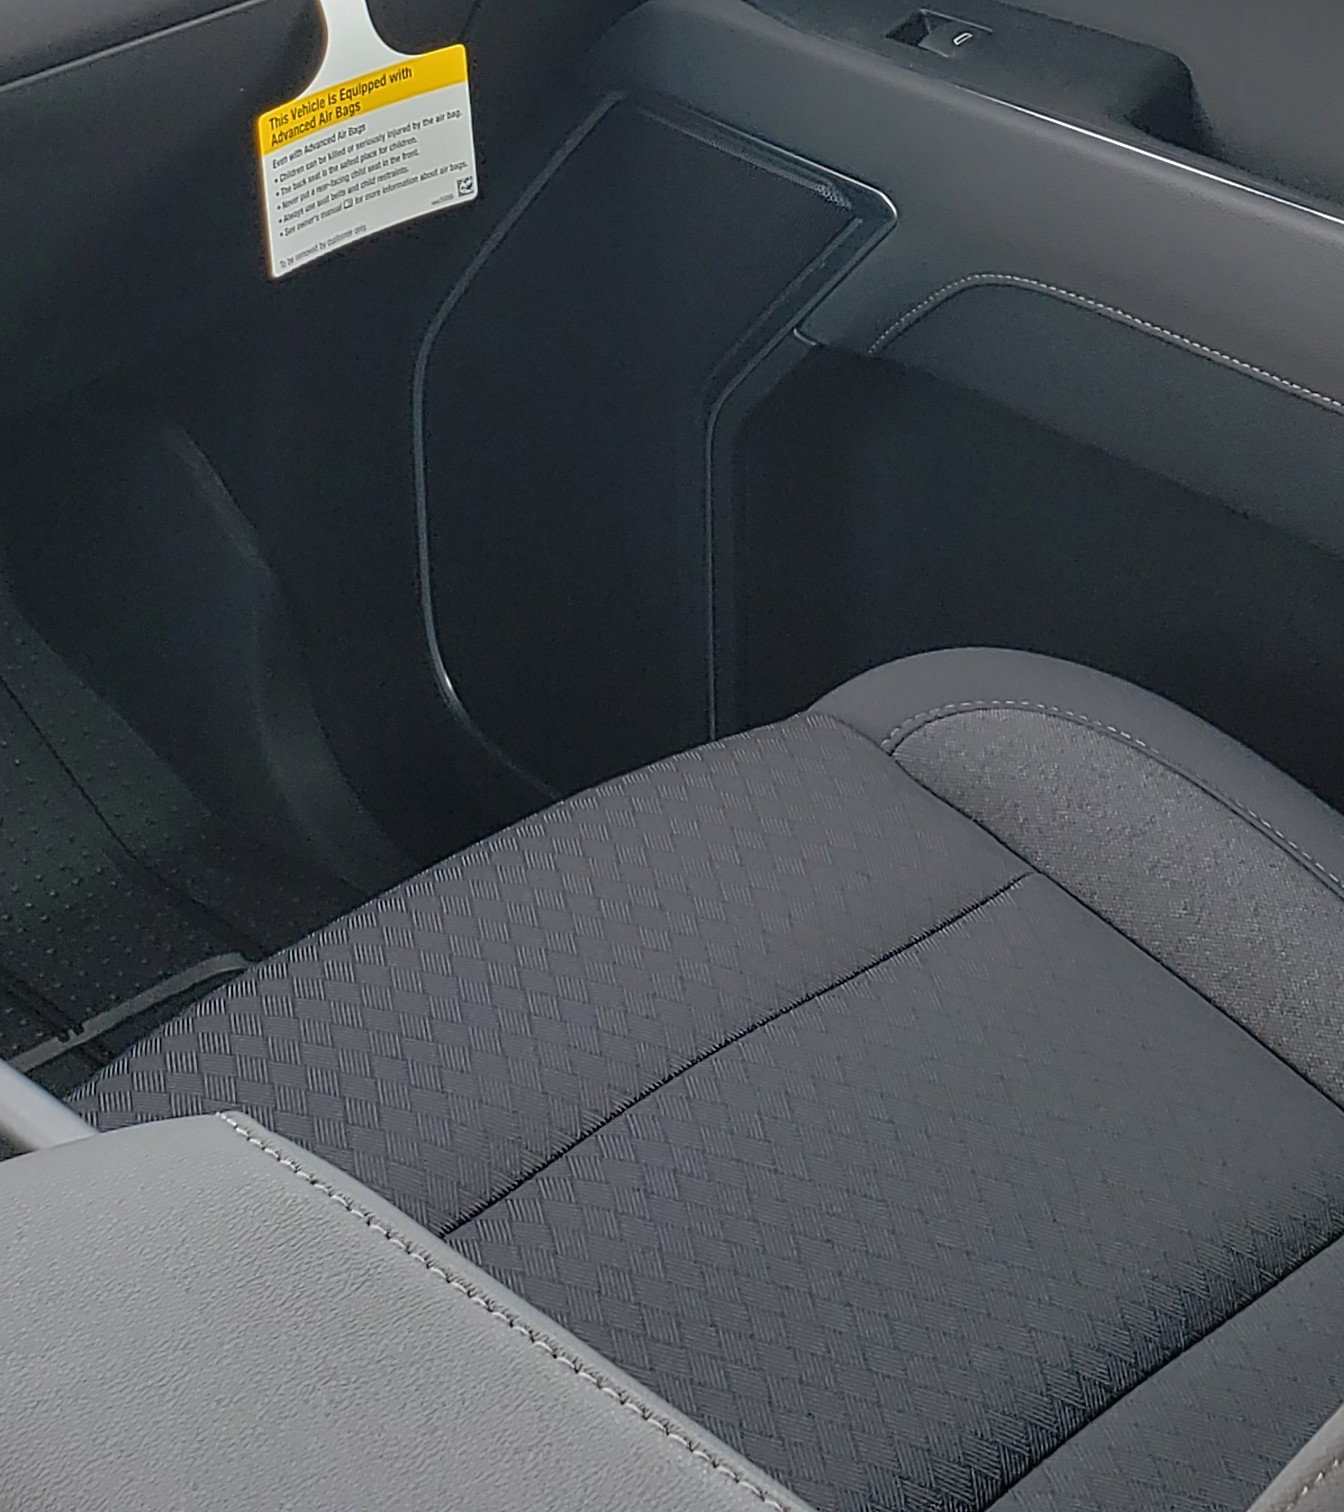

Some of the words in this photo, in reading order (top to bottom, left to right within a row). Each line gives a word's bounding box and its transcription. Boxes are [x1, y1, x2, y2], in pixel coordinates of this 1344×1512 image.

[269, 114, 289, 130] This
[290, 98, 325, 120] Vehicle
[327, 93, 337, 105] Is
[339, 74, 386, 101] Equipped
[389, 67, 412, 83] with
[271, 116, 316, 147] Advanced
[319, 111, 332, 126] Air
[336, 102, 361, 118] Bags
[304, 134, 336, 153] Advanced
[348, 124, 366, 136] Bags
[328, 148, 345, 159] killed
[412, 121, 421, 130] by
[422, 117, 434, 127] the
[435, 114, 445, 123] air
